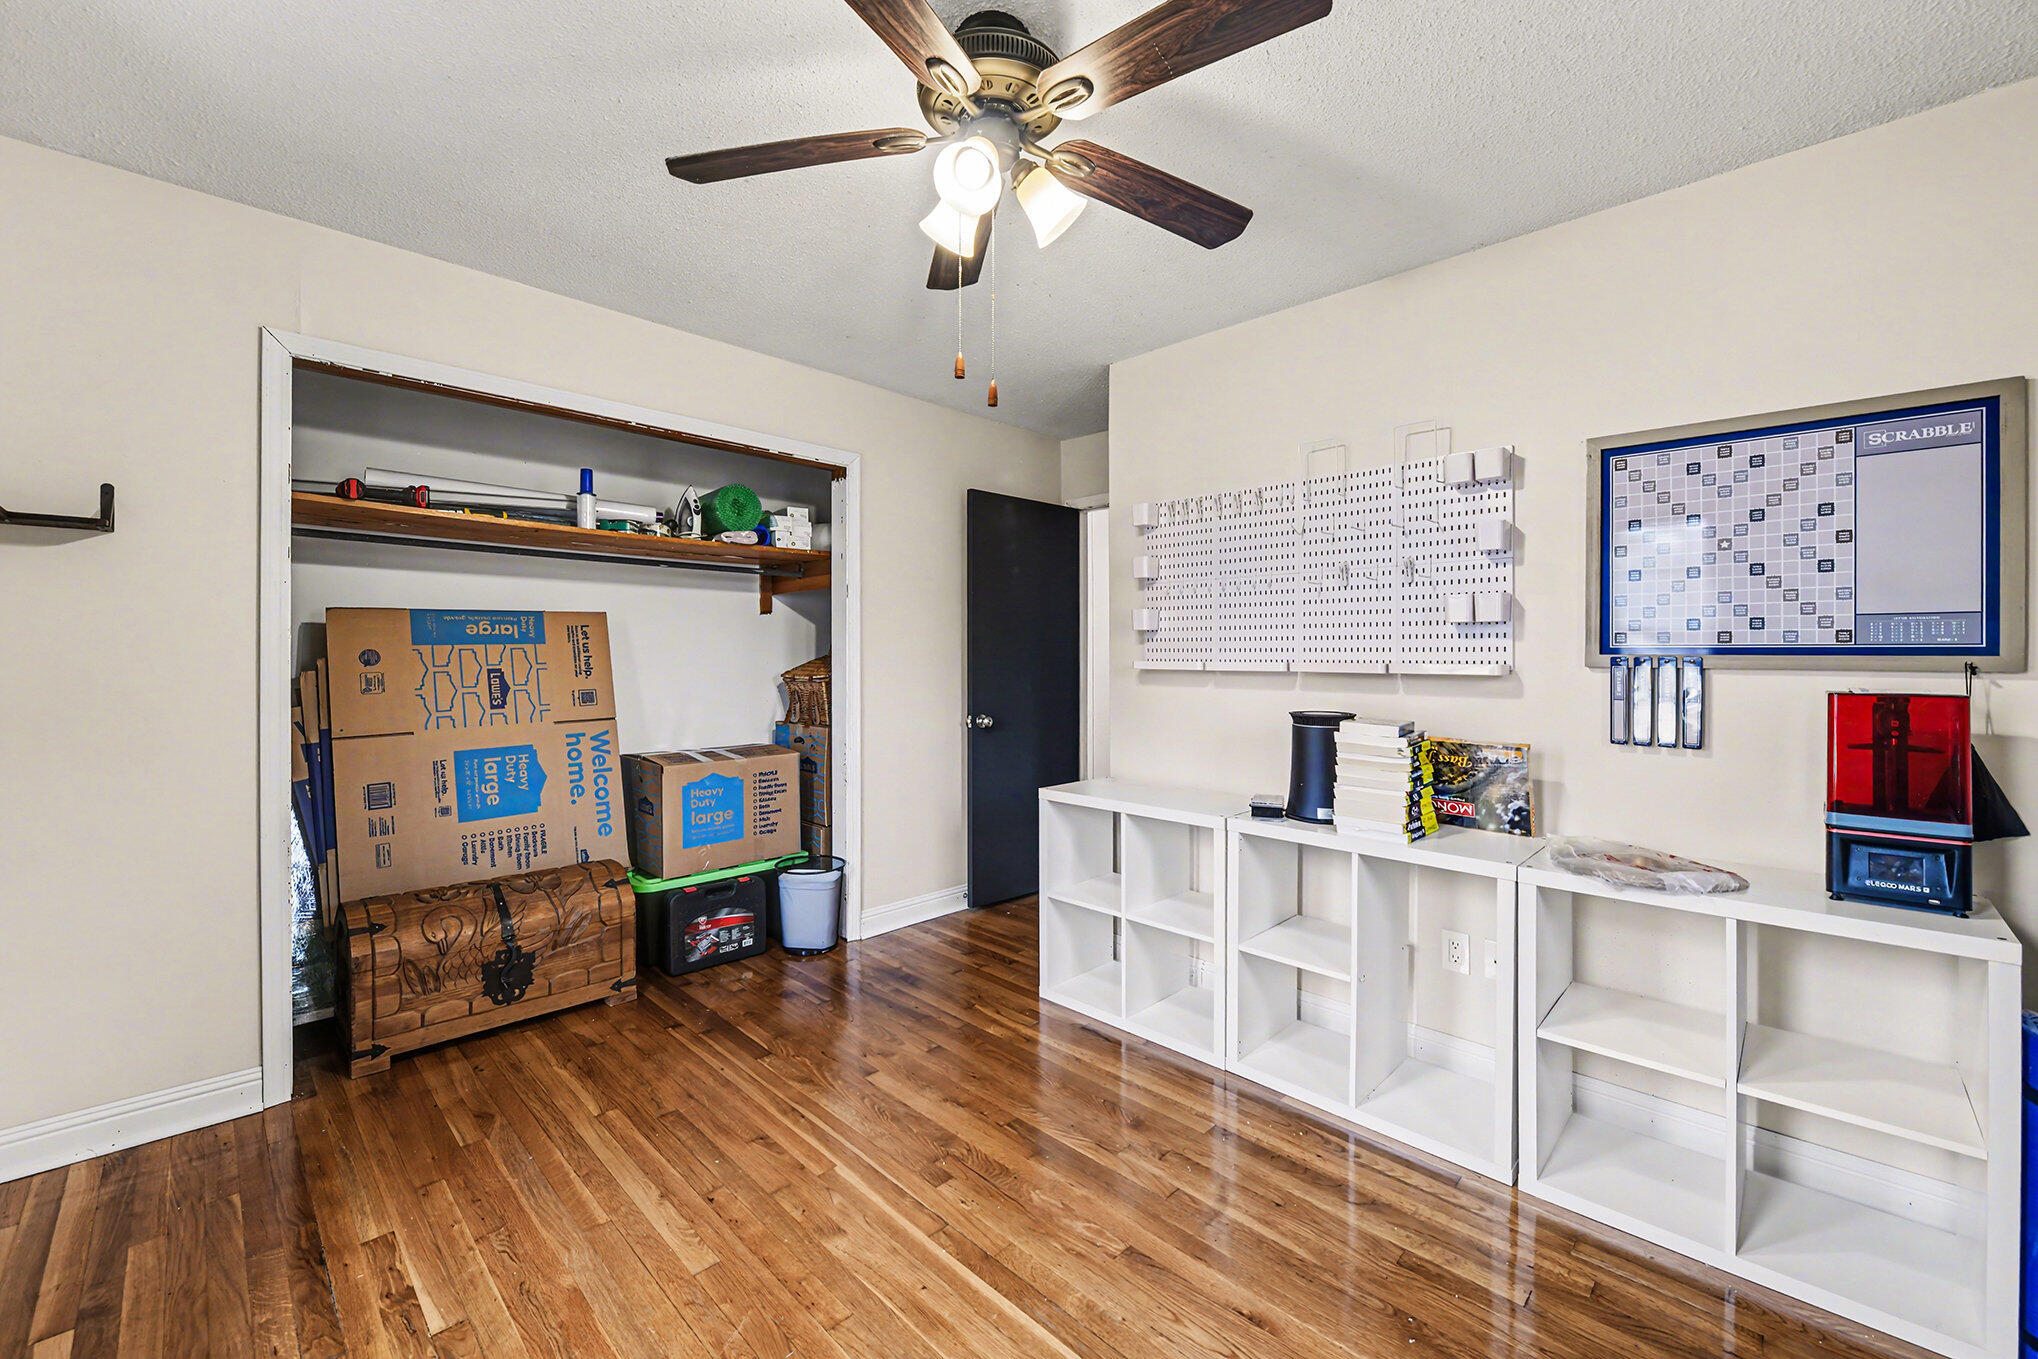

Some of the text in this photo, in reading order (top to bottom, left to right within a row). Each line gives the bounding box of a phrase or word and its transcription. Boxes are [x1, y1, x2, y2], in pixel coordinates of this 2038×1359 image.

[1868, 422, 1973, 445] SCRABBLE
[465, 621, 519, 639] large
[580, 624, 590, 641] Let
[582, 642, 589, 653] us
[504, 755, 516, 783] Duty
[565, 732, 586, 805] home.
[1438, 754, 1473, 768] Bass
[518, 754, 529, 790] Heavy
[481, 757, 501, 806] large
[590, 729, 612, 836] Welcome
[691, 788, 724, 798] Heavy
[691, 798, 716, 808] Duty
[692, 810, 734, 826] large
[1898, 884, 1922, 893] MARS
